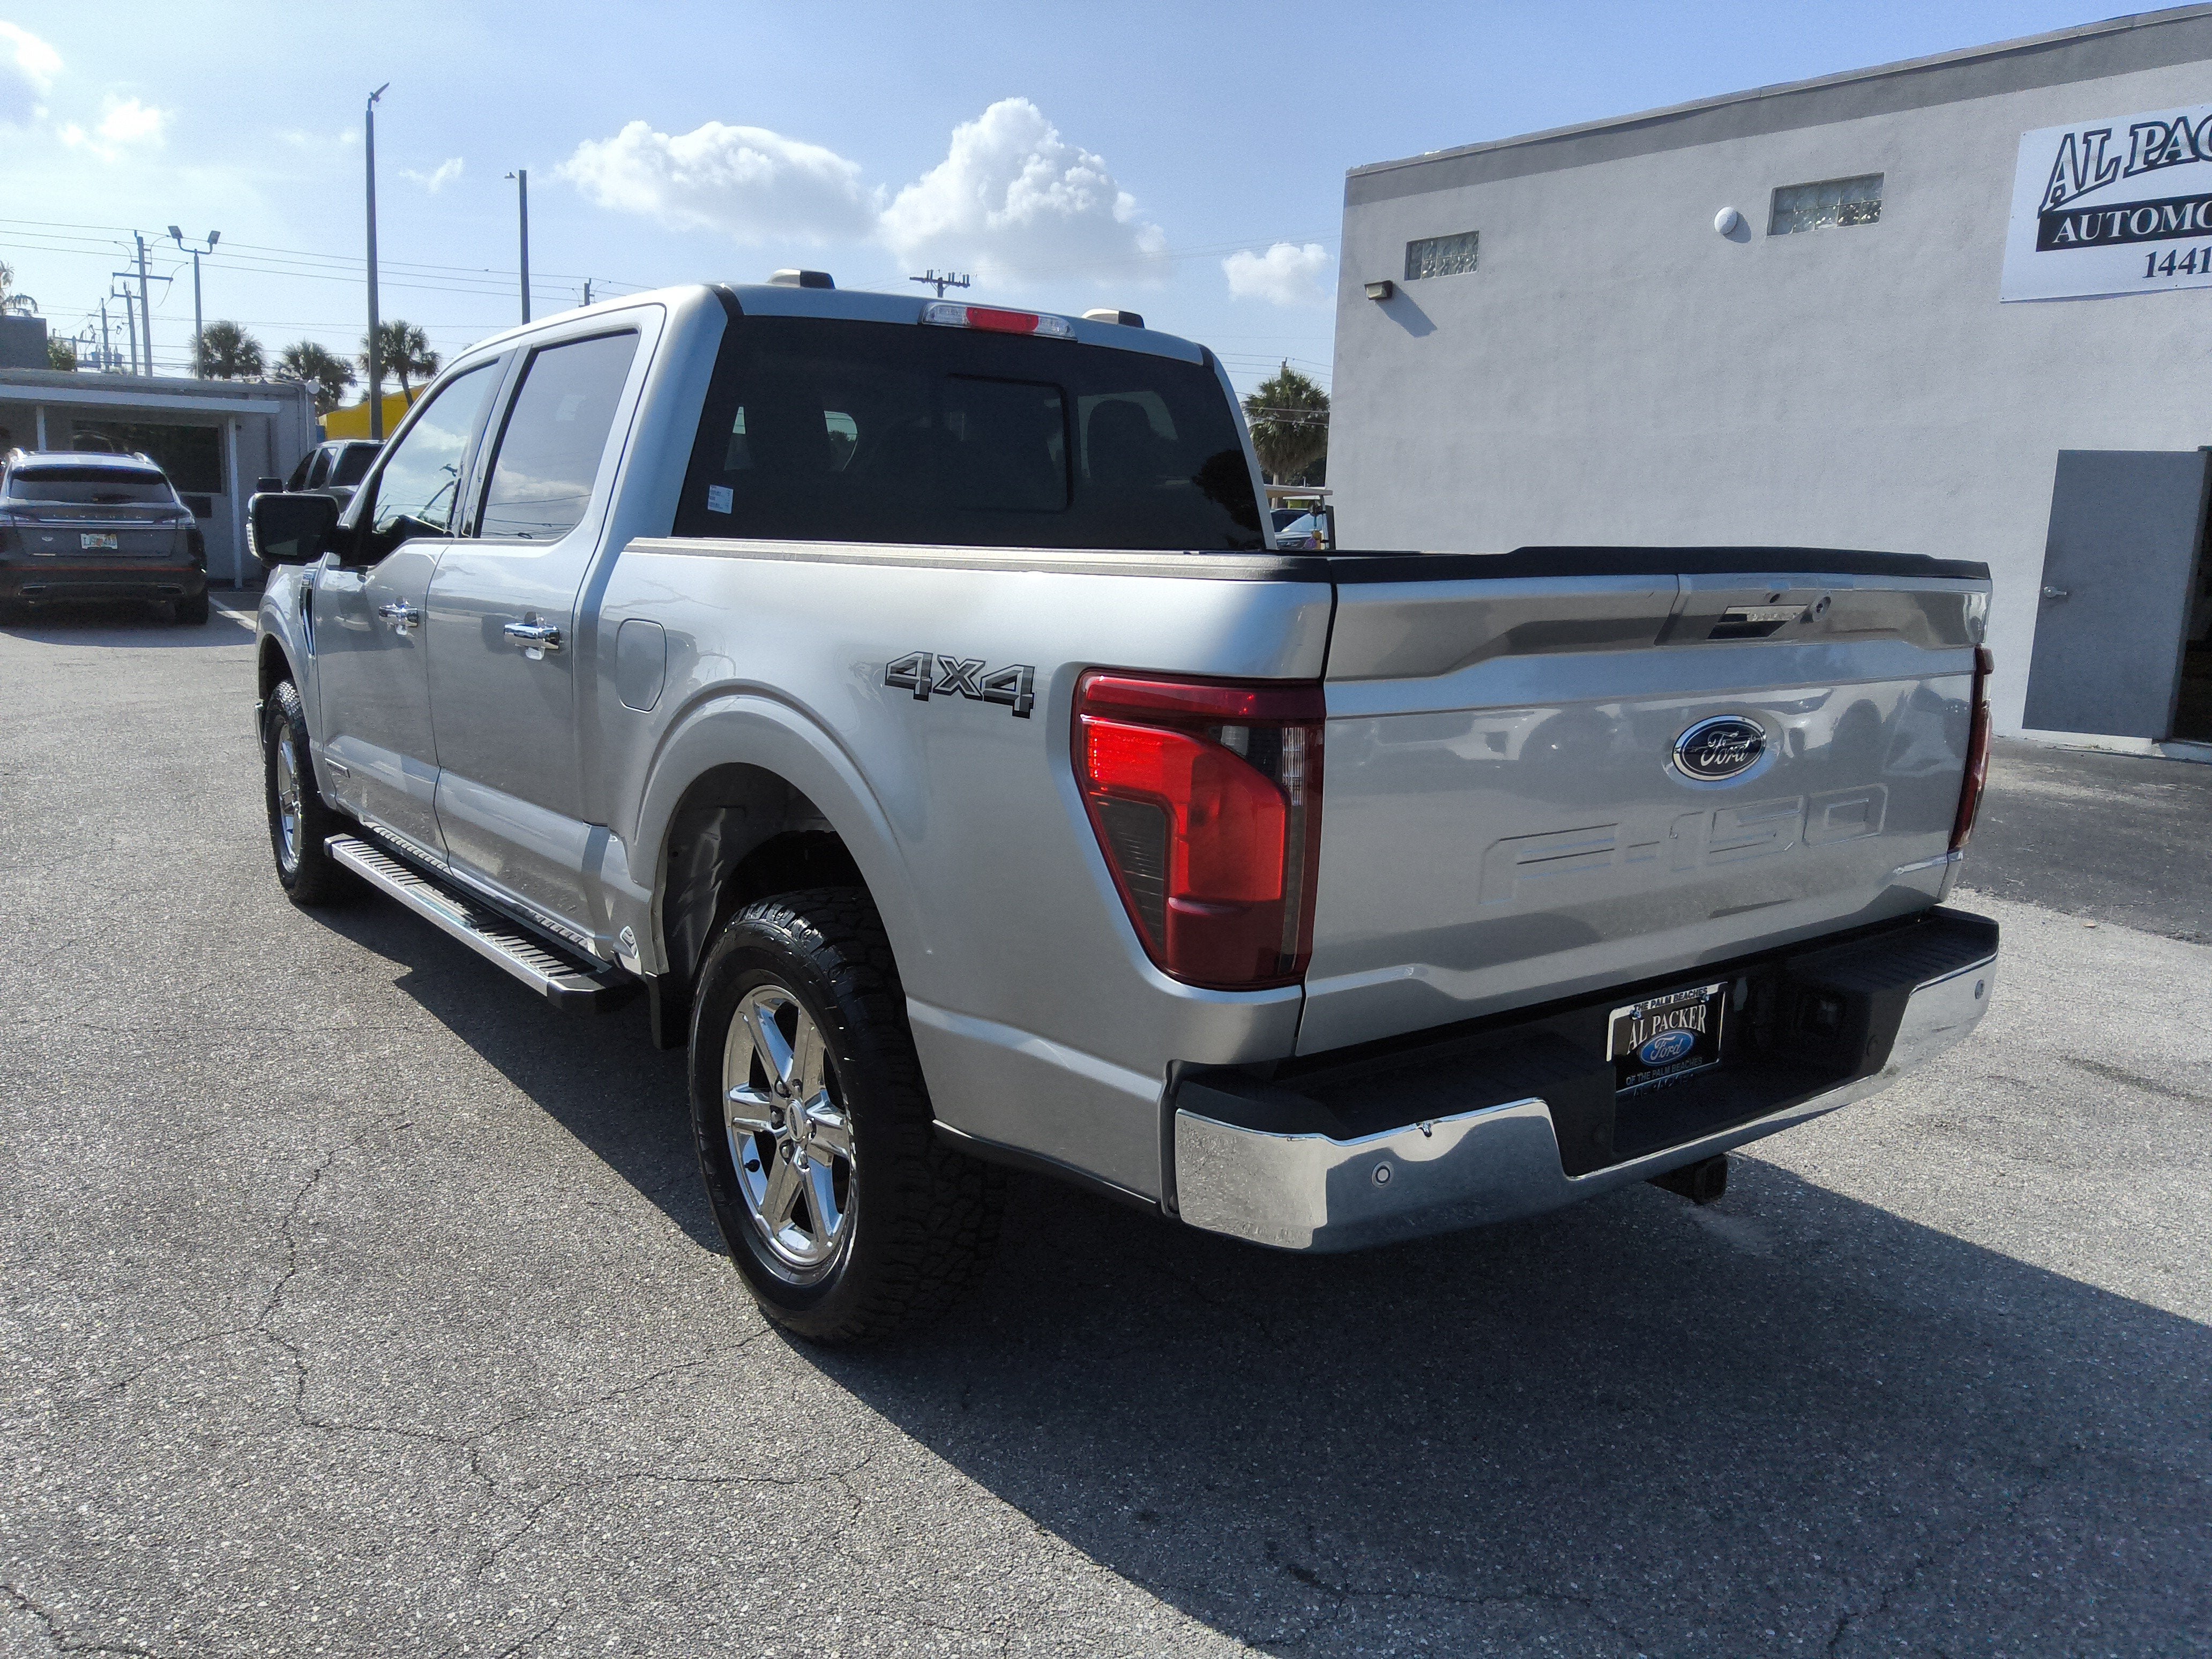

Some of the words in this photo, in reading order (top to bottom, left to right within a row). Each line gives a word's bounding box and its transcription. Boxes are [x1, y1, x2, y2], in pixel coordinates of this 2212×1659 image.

[2037, 128, 2123, 218] AL
[1700, 730, 1750, 766] Ford
[1650, 996, 1671, 1008] PALM
[1673, 988, 1708, 1002] BEACHES
[1626, 1018, 1648, 1056] AL
[1651, 1004, 1707, 1036] PACKER
[1650, 1036, 1684, 1060] Ford
[1626, 1075, 1636, 1086] OF
[1637, 1071, 1651, 1082] THE
[1652, 1065, 1670, 1079] PALM
[1671, 1057, 1703, 1072] BEACHES
